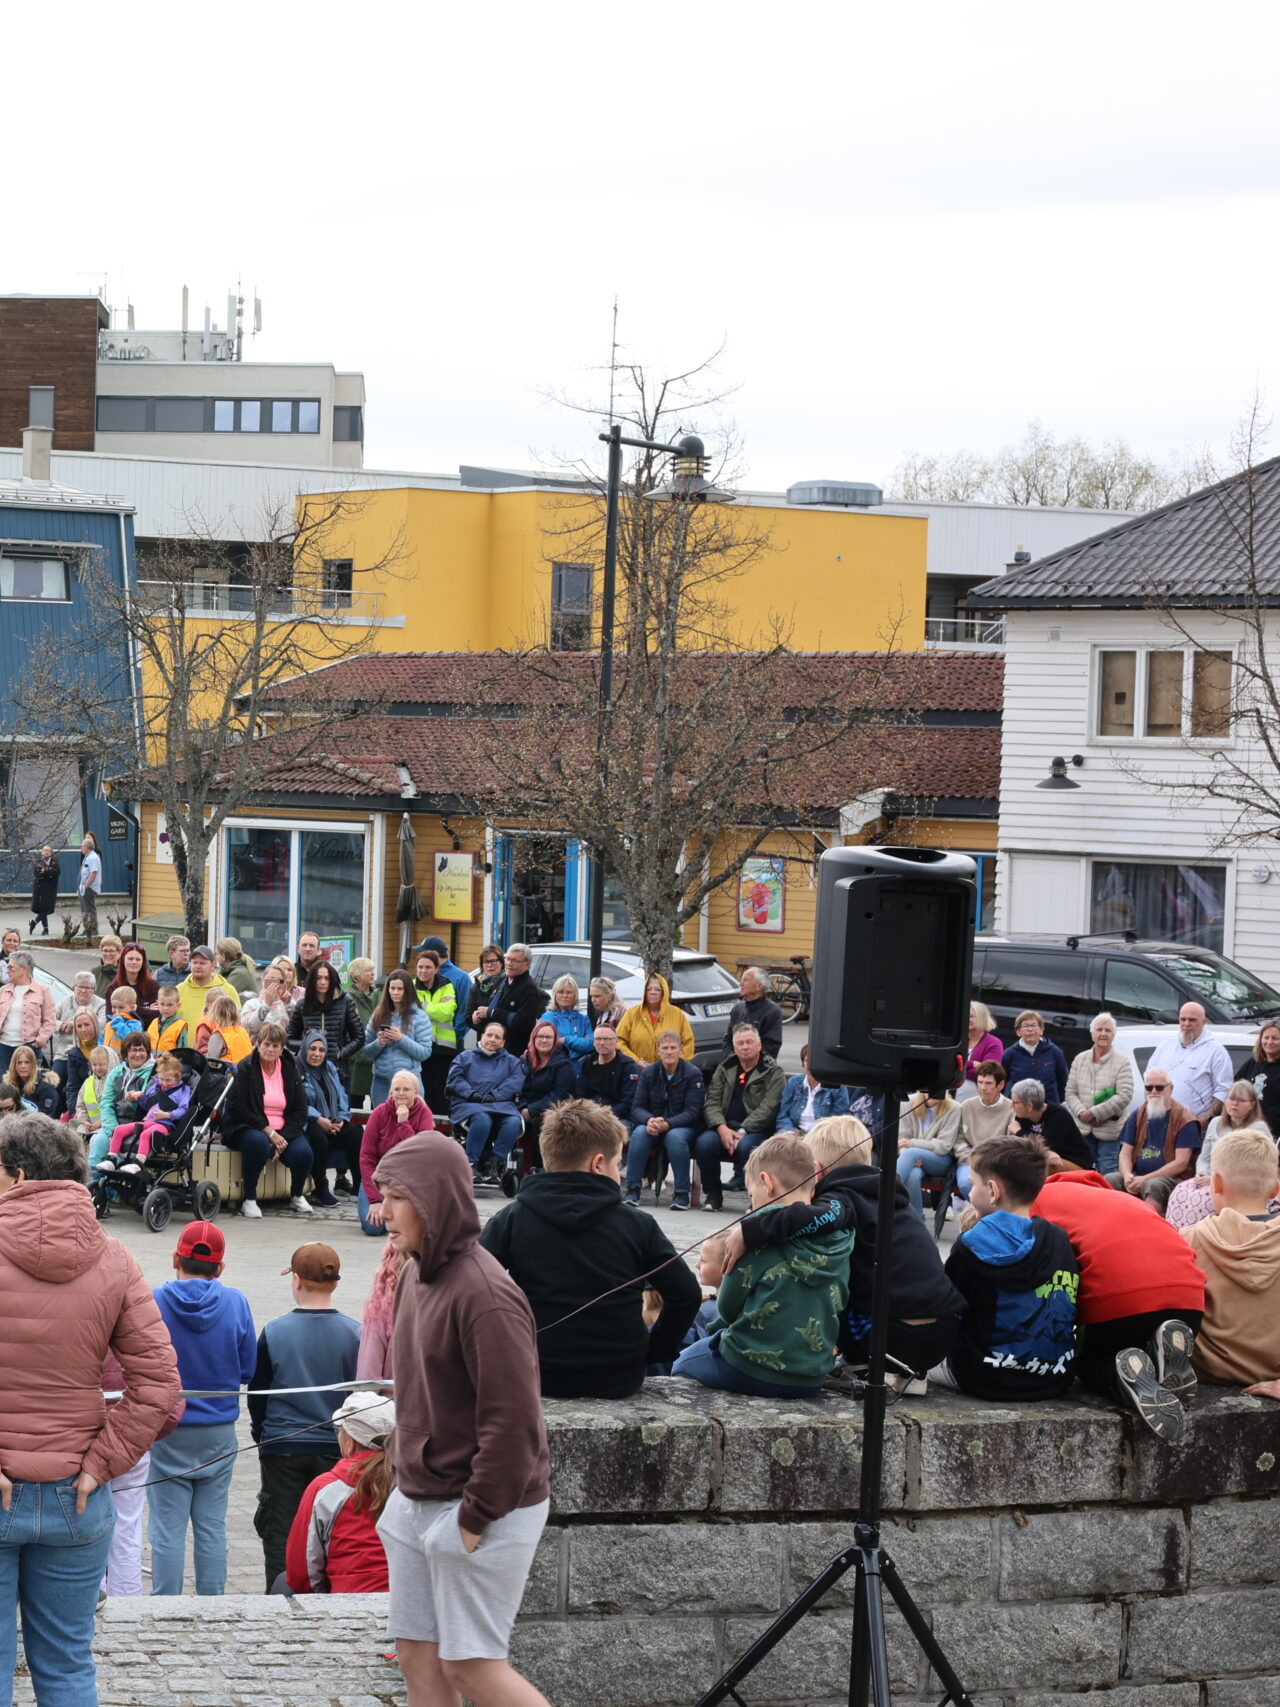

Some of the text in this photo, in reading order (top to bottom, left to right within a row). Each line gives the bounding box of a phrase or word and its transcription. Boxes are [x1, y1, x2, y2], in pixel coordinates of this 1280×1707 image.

[110, 820, 127, 828] VIKING
[312, 838, 363, 859] Karin's
[1052, 1269, 1080, 1289] TAR
[1035, 1284, 1077, 1304] WAR
